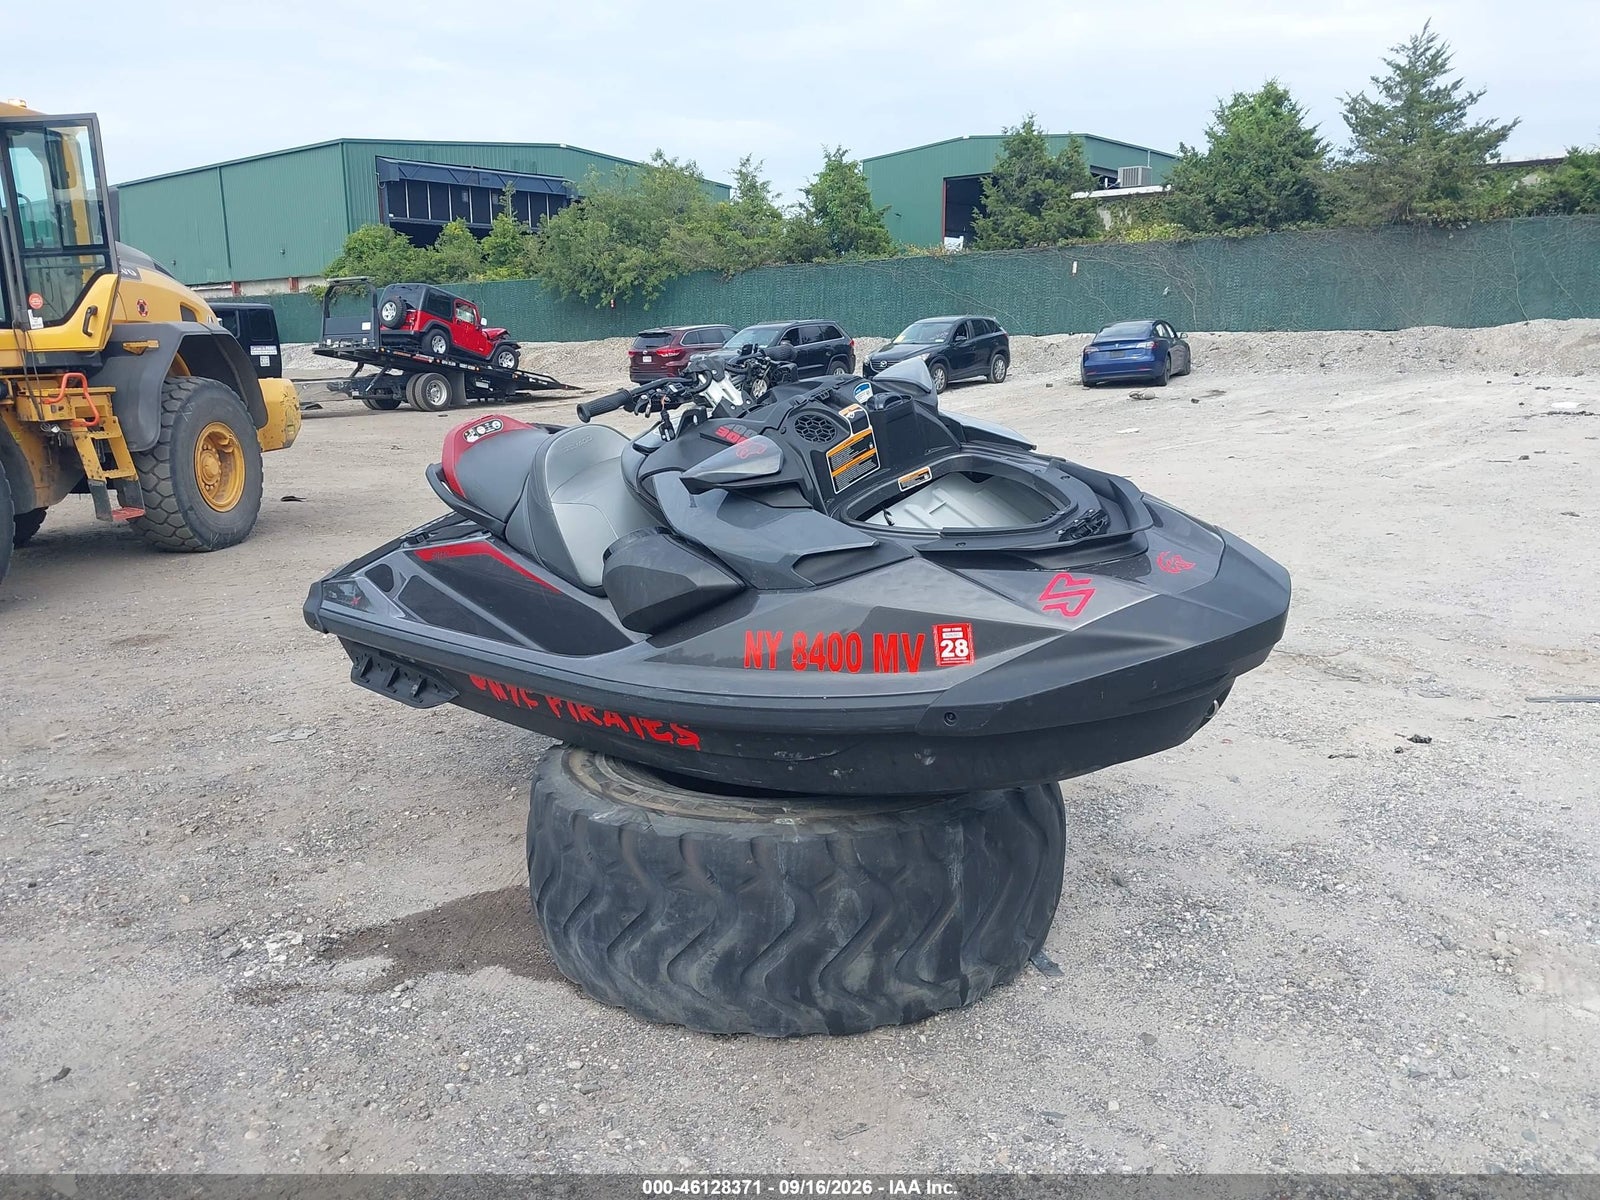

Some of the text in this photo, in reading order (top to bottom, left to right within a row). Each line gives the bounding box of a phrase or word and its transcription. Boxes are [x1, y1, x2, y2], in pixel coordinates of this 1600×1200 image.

[743, 629, 927, 675] NY 8400 MV
[940, 639, 969, 658] 28
